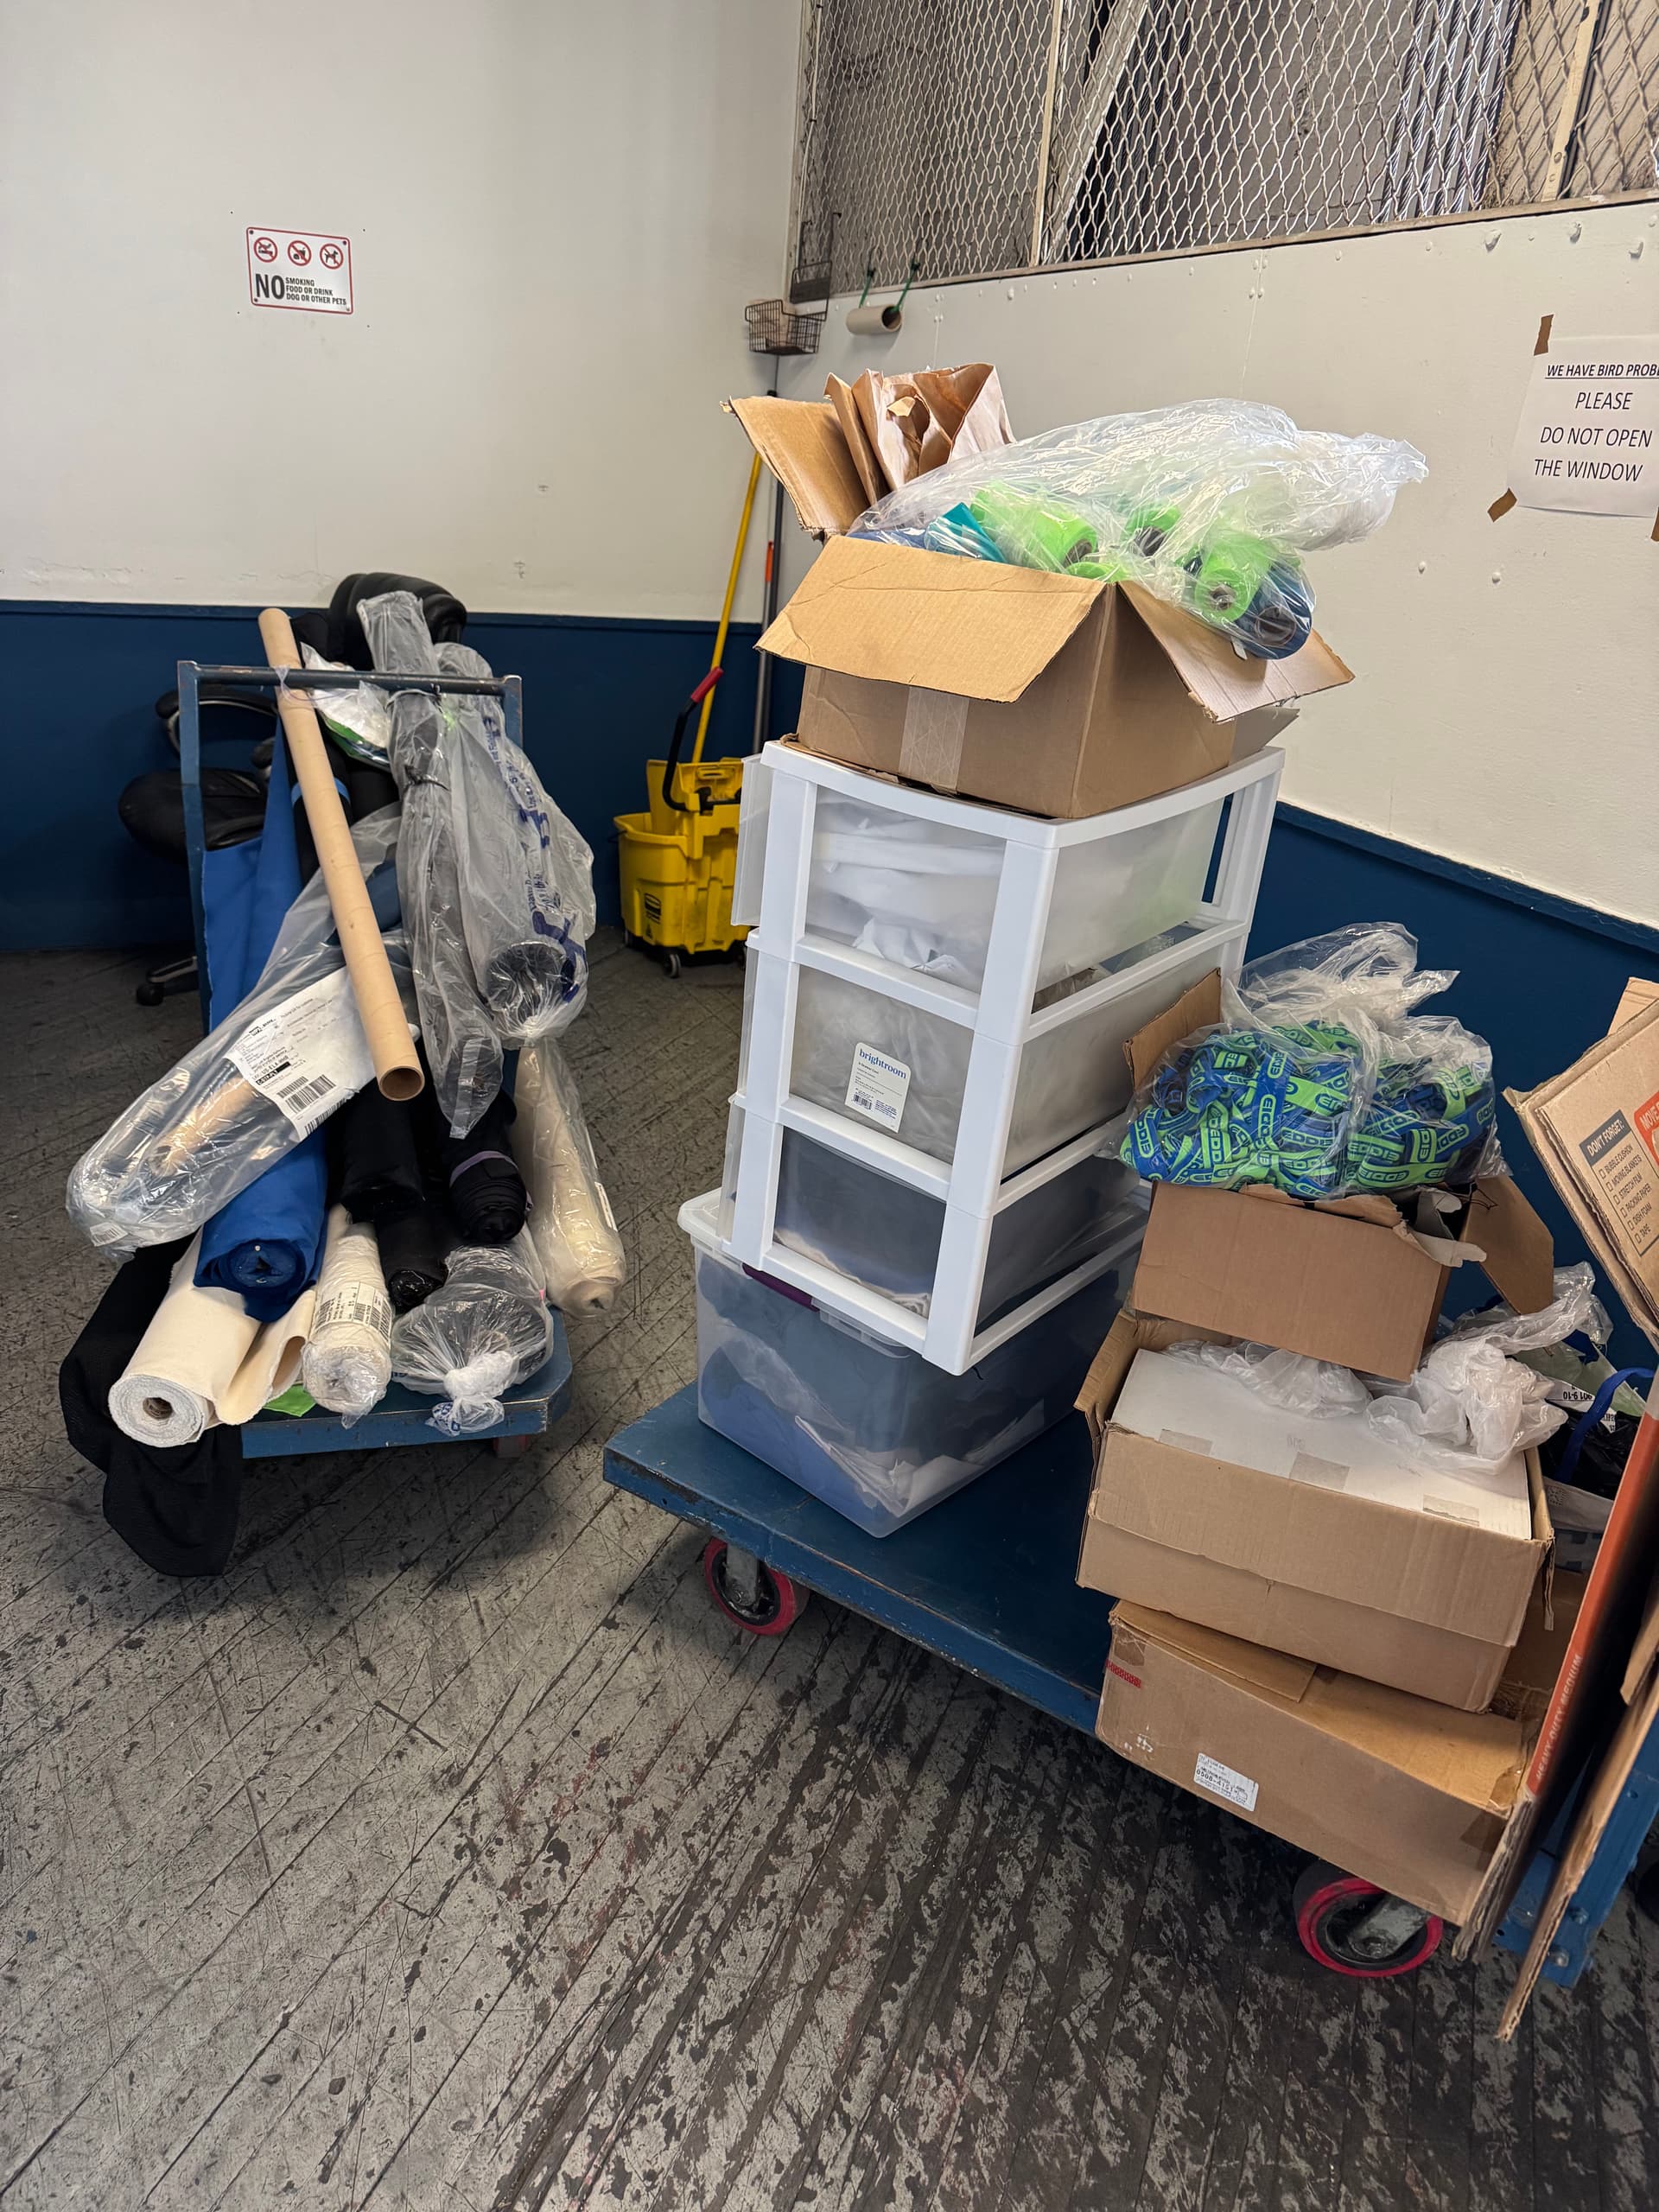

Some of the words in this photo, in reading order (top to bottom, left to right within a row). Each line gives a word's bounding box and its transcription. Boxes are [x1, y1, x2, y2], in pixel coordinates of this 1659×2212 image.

[255, 273, 285, 300] NO
[285, 276, 315, 286] SMOKING
[286, 293, 300, 302] DOG
[311, 296, 330, 304] OTHER
[332, 297, 346, 306] PETS
[314, 287, 334, 296] DRINK
[1547, 365, 1564, 377] WE
[1566, 365, 1596, 377] HAVE
[1598, 364, 1624, 377] BIRD
[1575, 391, 1633, 410] PLEASE
[1540, 427, 1564, 444] DO
[1567, 428, 1604, 445] NOT
[1605, 429, 1653, 448] OPEN
[1535, 459, 1563, 478] THE
[1567, 461, 1643, 482] WINDOW
[859, 1048, 906, 1079] brightroom
